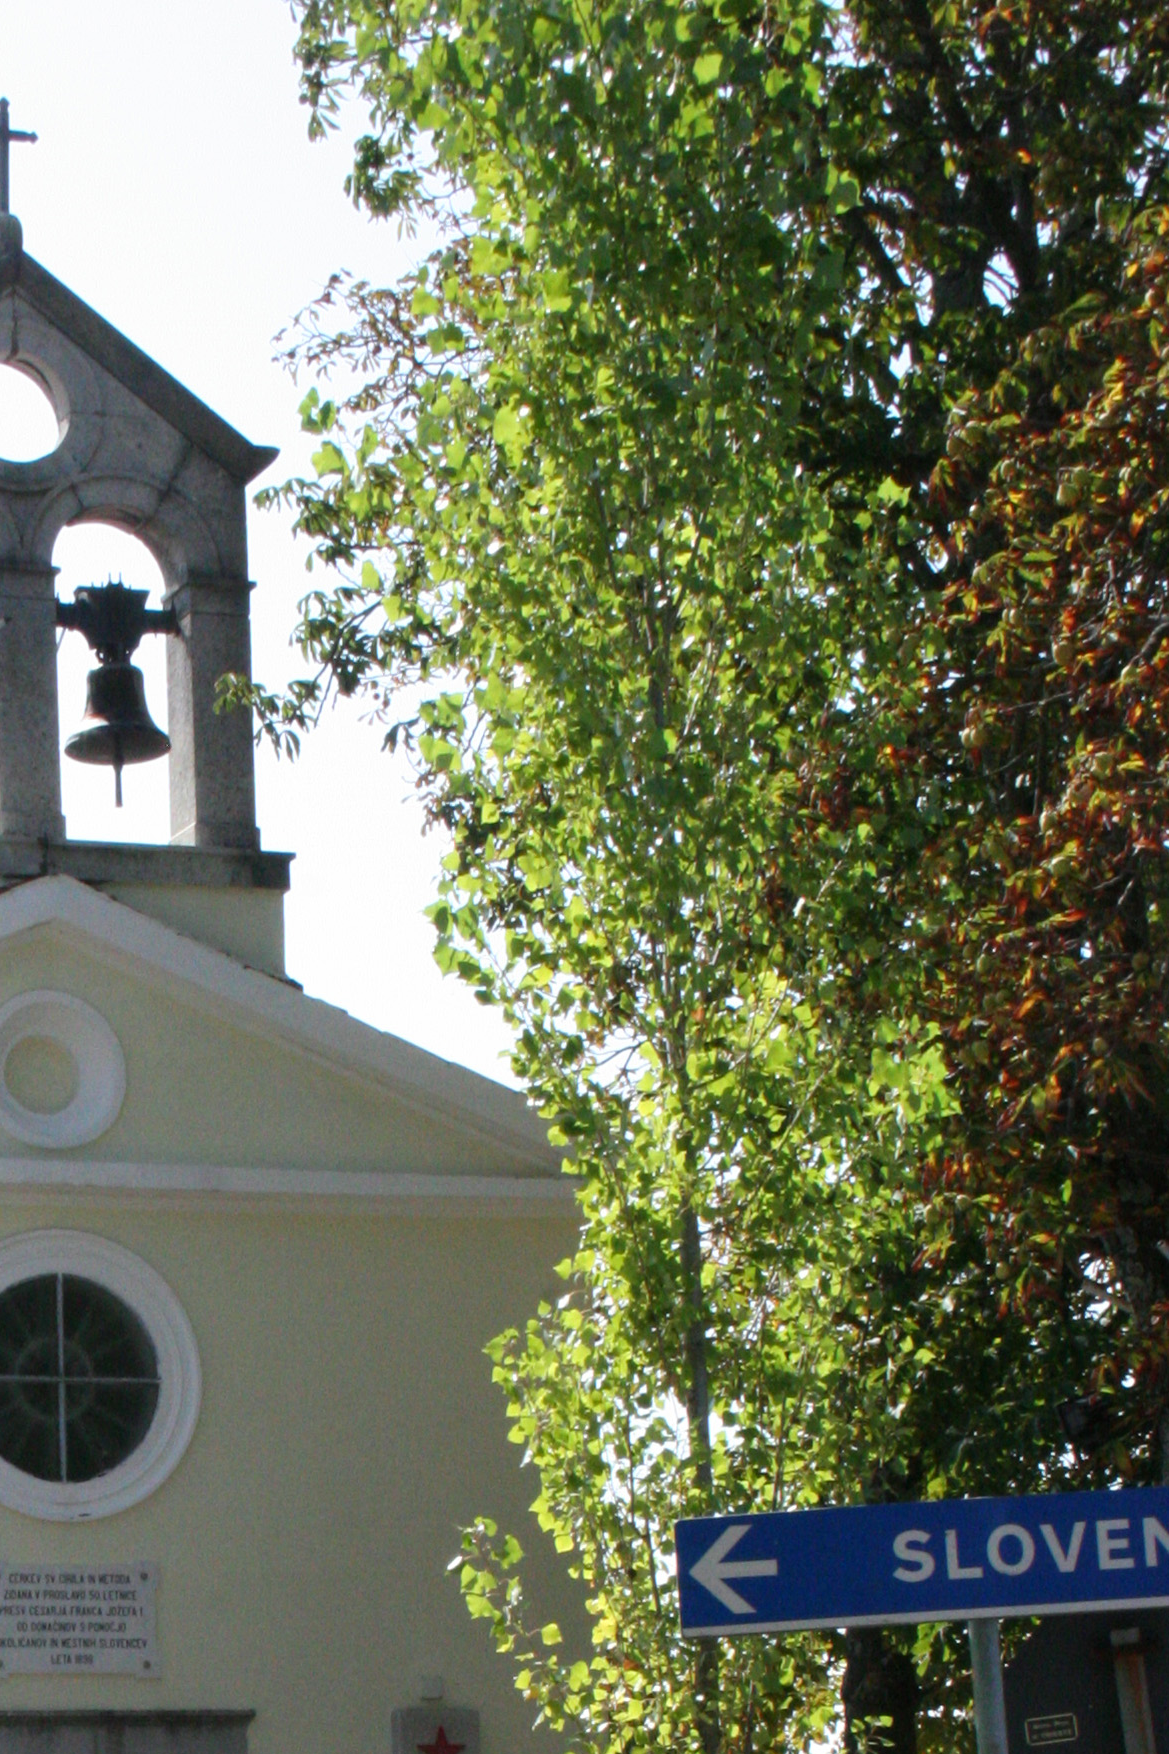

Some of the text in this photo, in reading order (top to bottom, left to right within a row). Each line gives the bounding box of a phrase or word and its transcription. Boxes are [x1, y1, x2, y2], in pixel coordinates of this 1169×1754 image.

[892, 1516, 1169, 1583] SLOVEN
[87, 1573, 97, 1584] IN
[98, 1573, 131, 1584] METODA
[4, 1589, 33, 1600] ZIDANA
[34, 1589, 40, 1600] V
[43, 1589, 86, 1600] PROSLAVO
[103, 1590, 137, 1601] LETNICE
[29, 1605, 67, 1616] CESARJA
[70, 1606, 102, 1616] FRANCA
[16, 1621, 28, 1632] OD
[50, 1637, 59, 1648] IN
[61, 1637, 96, 1648] MESTNIH
[99, 1637, 148, 1649] SLOVENCEV
[50, 1654, 72, 1665] LETA
